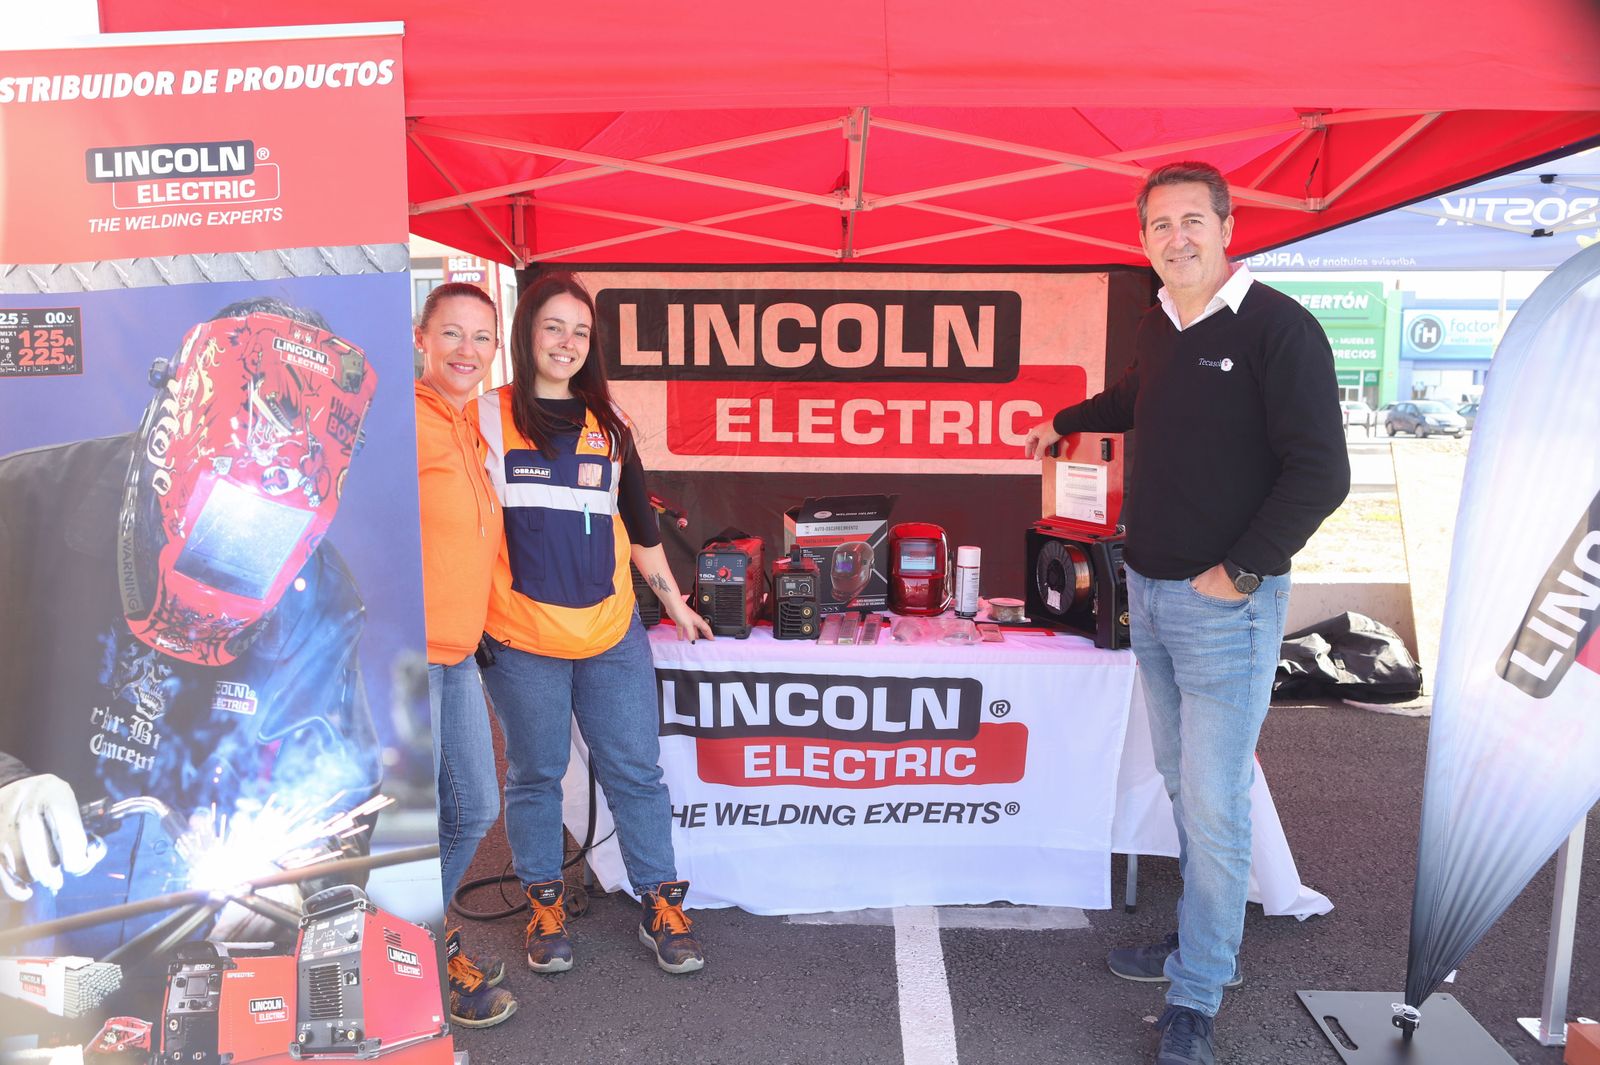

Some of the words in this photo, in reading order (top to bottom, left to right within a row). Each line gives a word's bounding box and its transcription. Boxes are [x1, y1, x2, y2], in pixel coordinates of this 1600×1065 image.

[182, 69, 219, 95] DE
[225, 59, 395, 93] PRODUCTOS
[94, 146, 246, 179] LINCOLN
[136, 178, 256, 204] ELECTRIC
[88, 218, 120, 233] THE
[125, 212, 202, 231] WELDING
[207, 207, 283, 226] EXPERTS
[448, 257, 486, 271] BELL
[451, 271, 481, 282] AUTO
[618, 302, 996, 369] LINCOLN
[275, 339, 326, 364] LINCOLN
[286, 353, 330, 375] ELECTRIC
[715, 398, 1044, 447] ELECTRIC
[514, 468, 550, 477] OBRAMAT
[122, 537, 139, 612] WARNING
[661, 680, 963, 733] LINCOLN
[743, 744, 978, 782] ELECTRIC
[714, 802, 857, 828] WELDING
[251, 999, 283, 1012] LINCOLN
[258, 1011, 286, 1022] ELECTRIC
